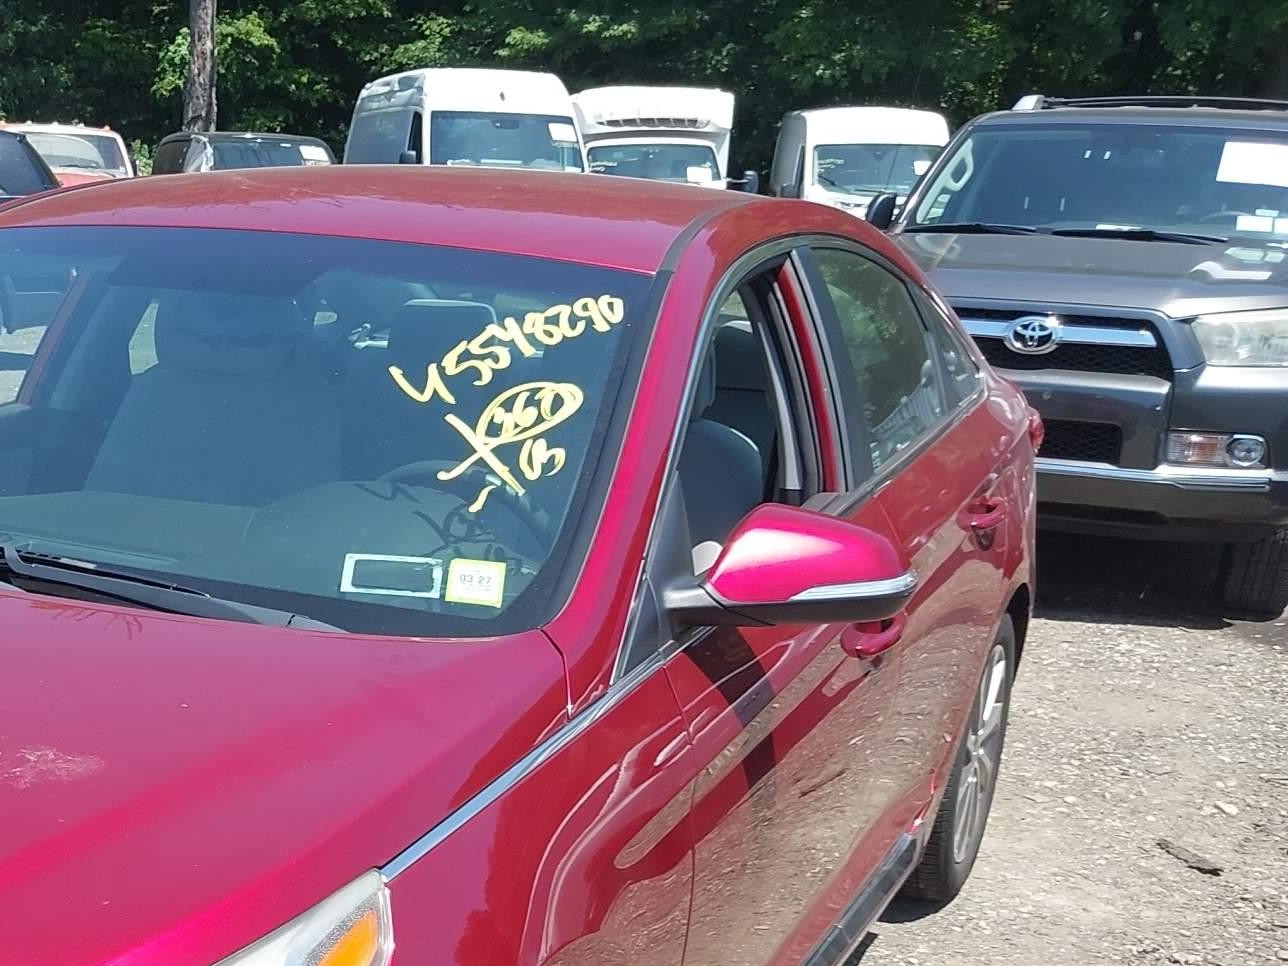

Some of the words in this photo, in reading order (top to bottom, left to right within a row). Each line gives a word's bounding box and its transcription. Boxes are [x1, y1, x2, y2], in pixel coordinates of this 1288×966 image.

[388, 294, 624, 406] 45548290
[459, 574, 474, 583] 03
[478, 575, 492, 583] 27
